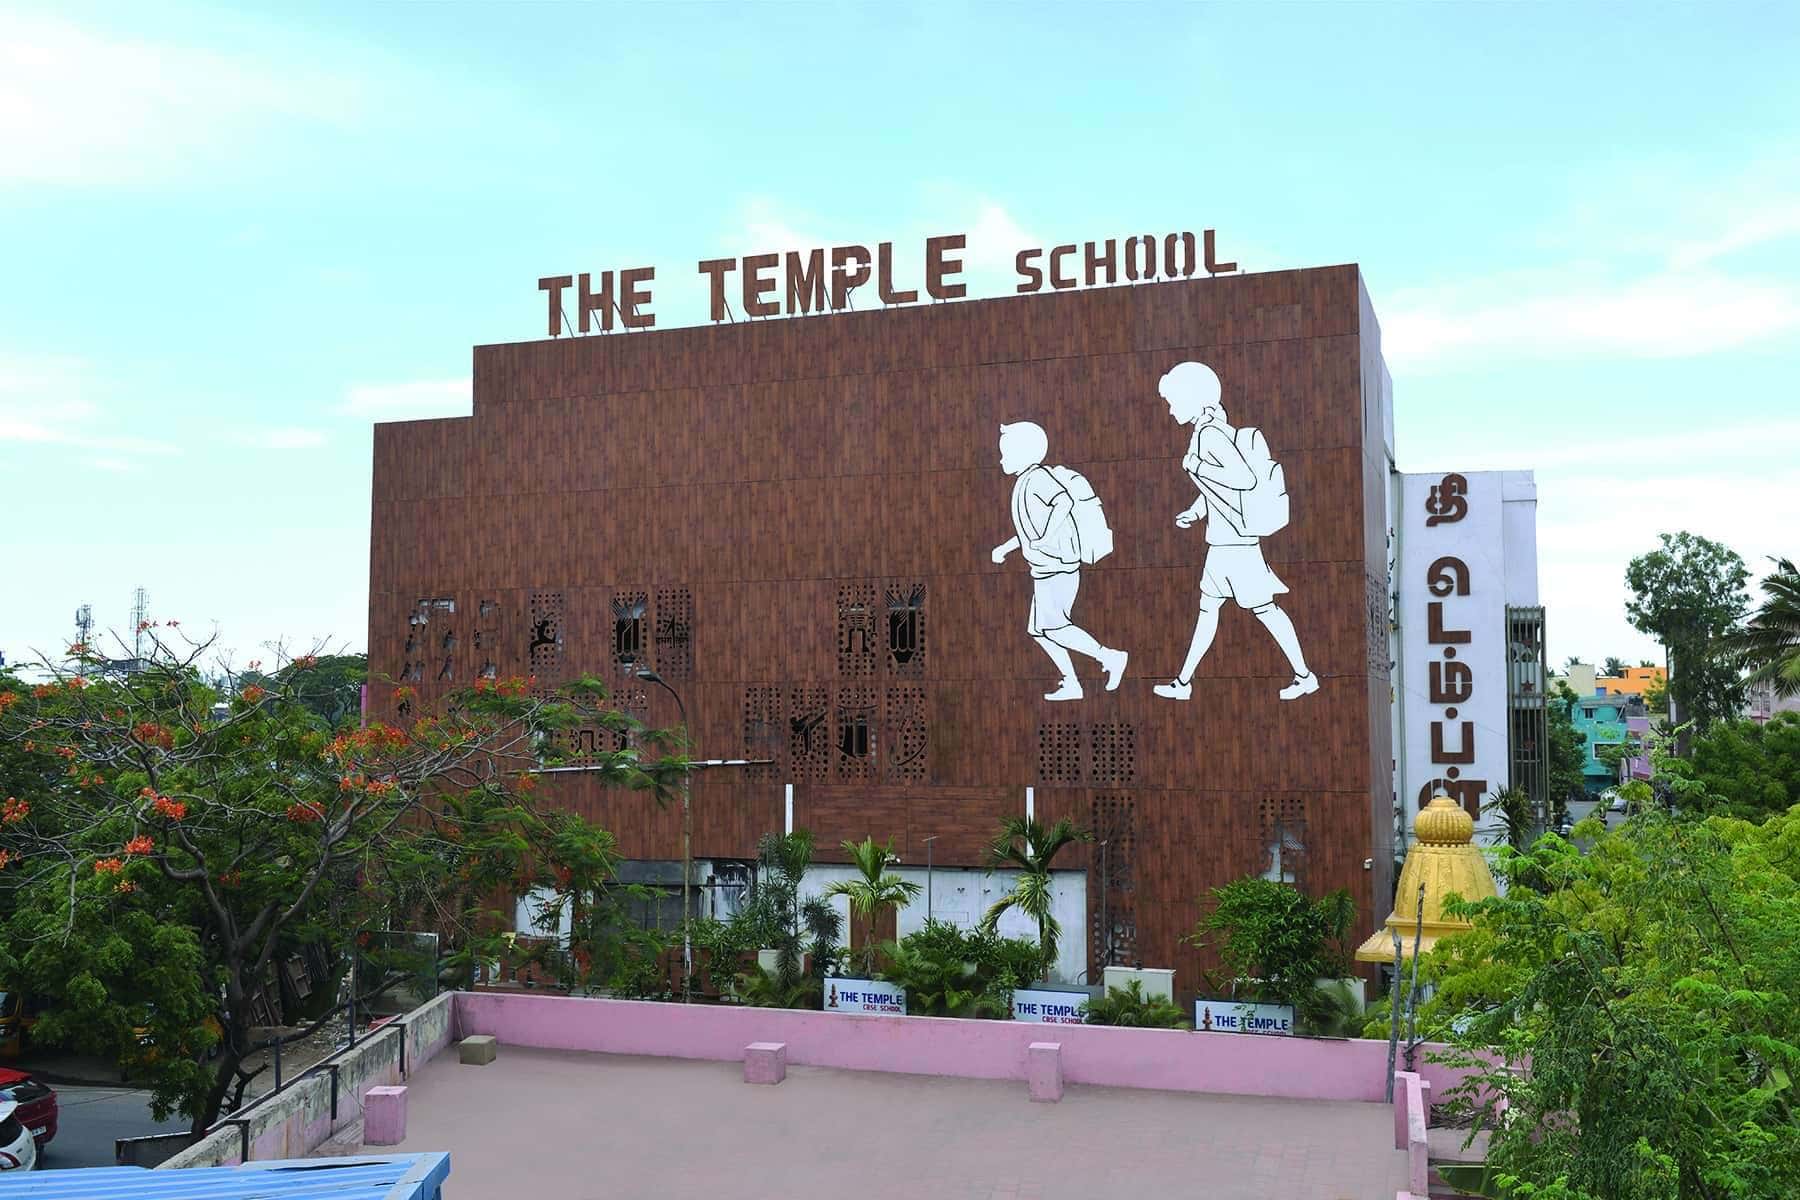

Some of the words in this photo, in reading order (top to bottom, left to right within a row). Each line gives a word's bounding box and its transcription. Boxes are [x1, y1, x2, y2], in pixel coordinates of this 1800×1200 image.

[538, 266, 655, 337] THE
[698, 234, 967, 321] TEMPLE
[1016, 229, 1237, 293] SCHOOL
[840, 991, 859, 1003] THE
[862, 993, 903, 1006] TEMPLE
[880, 1005, 902, 1013] SCHOOL
[1017, 1003, 1037, 1015] THE
[1215, 1015, 1237, 1028] THE
